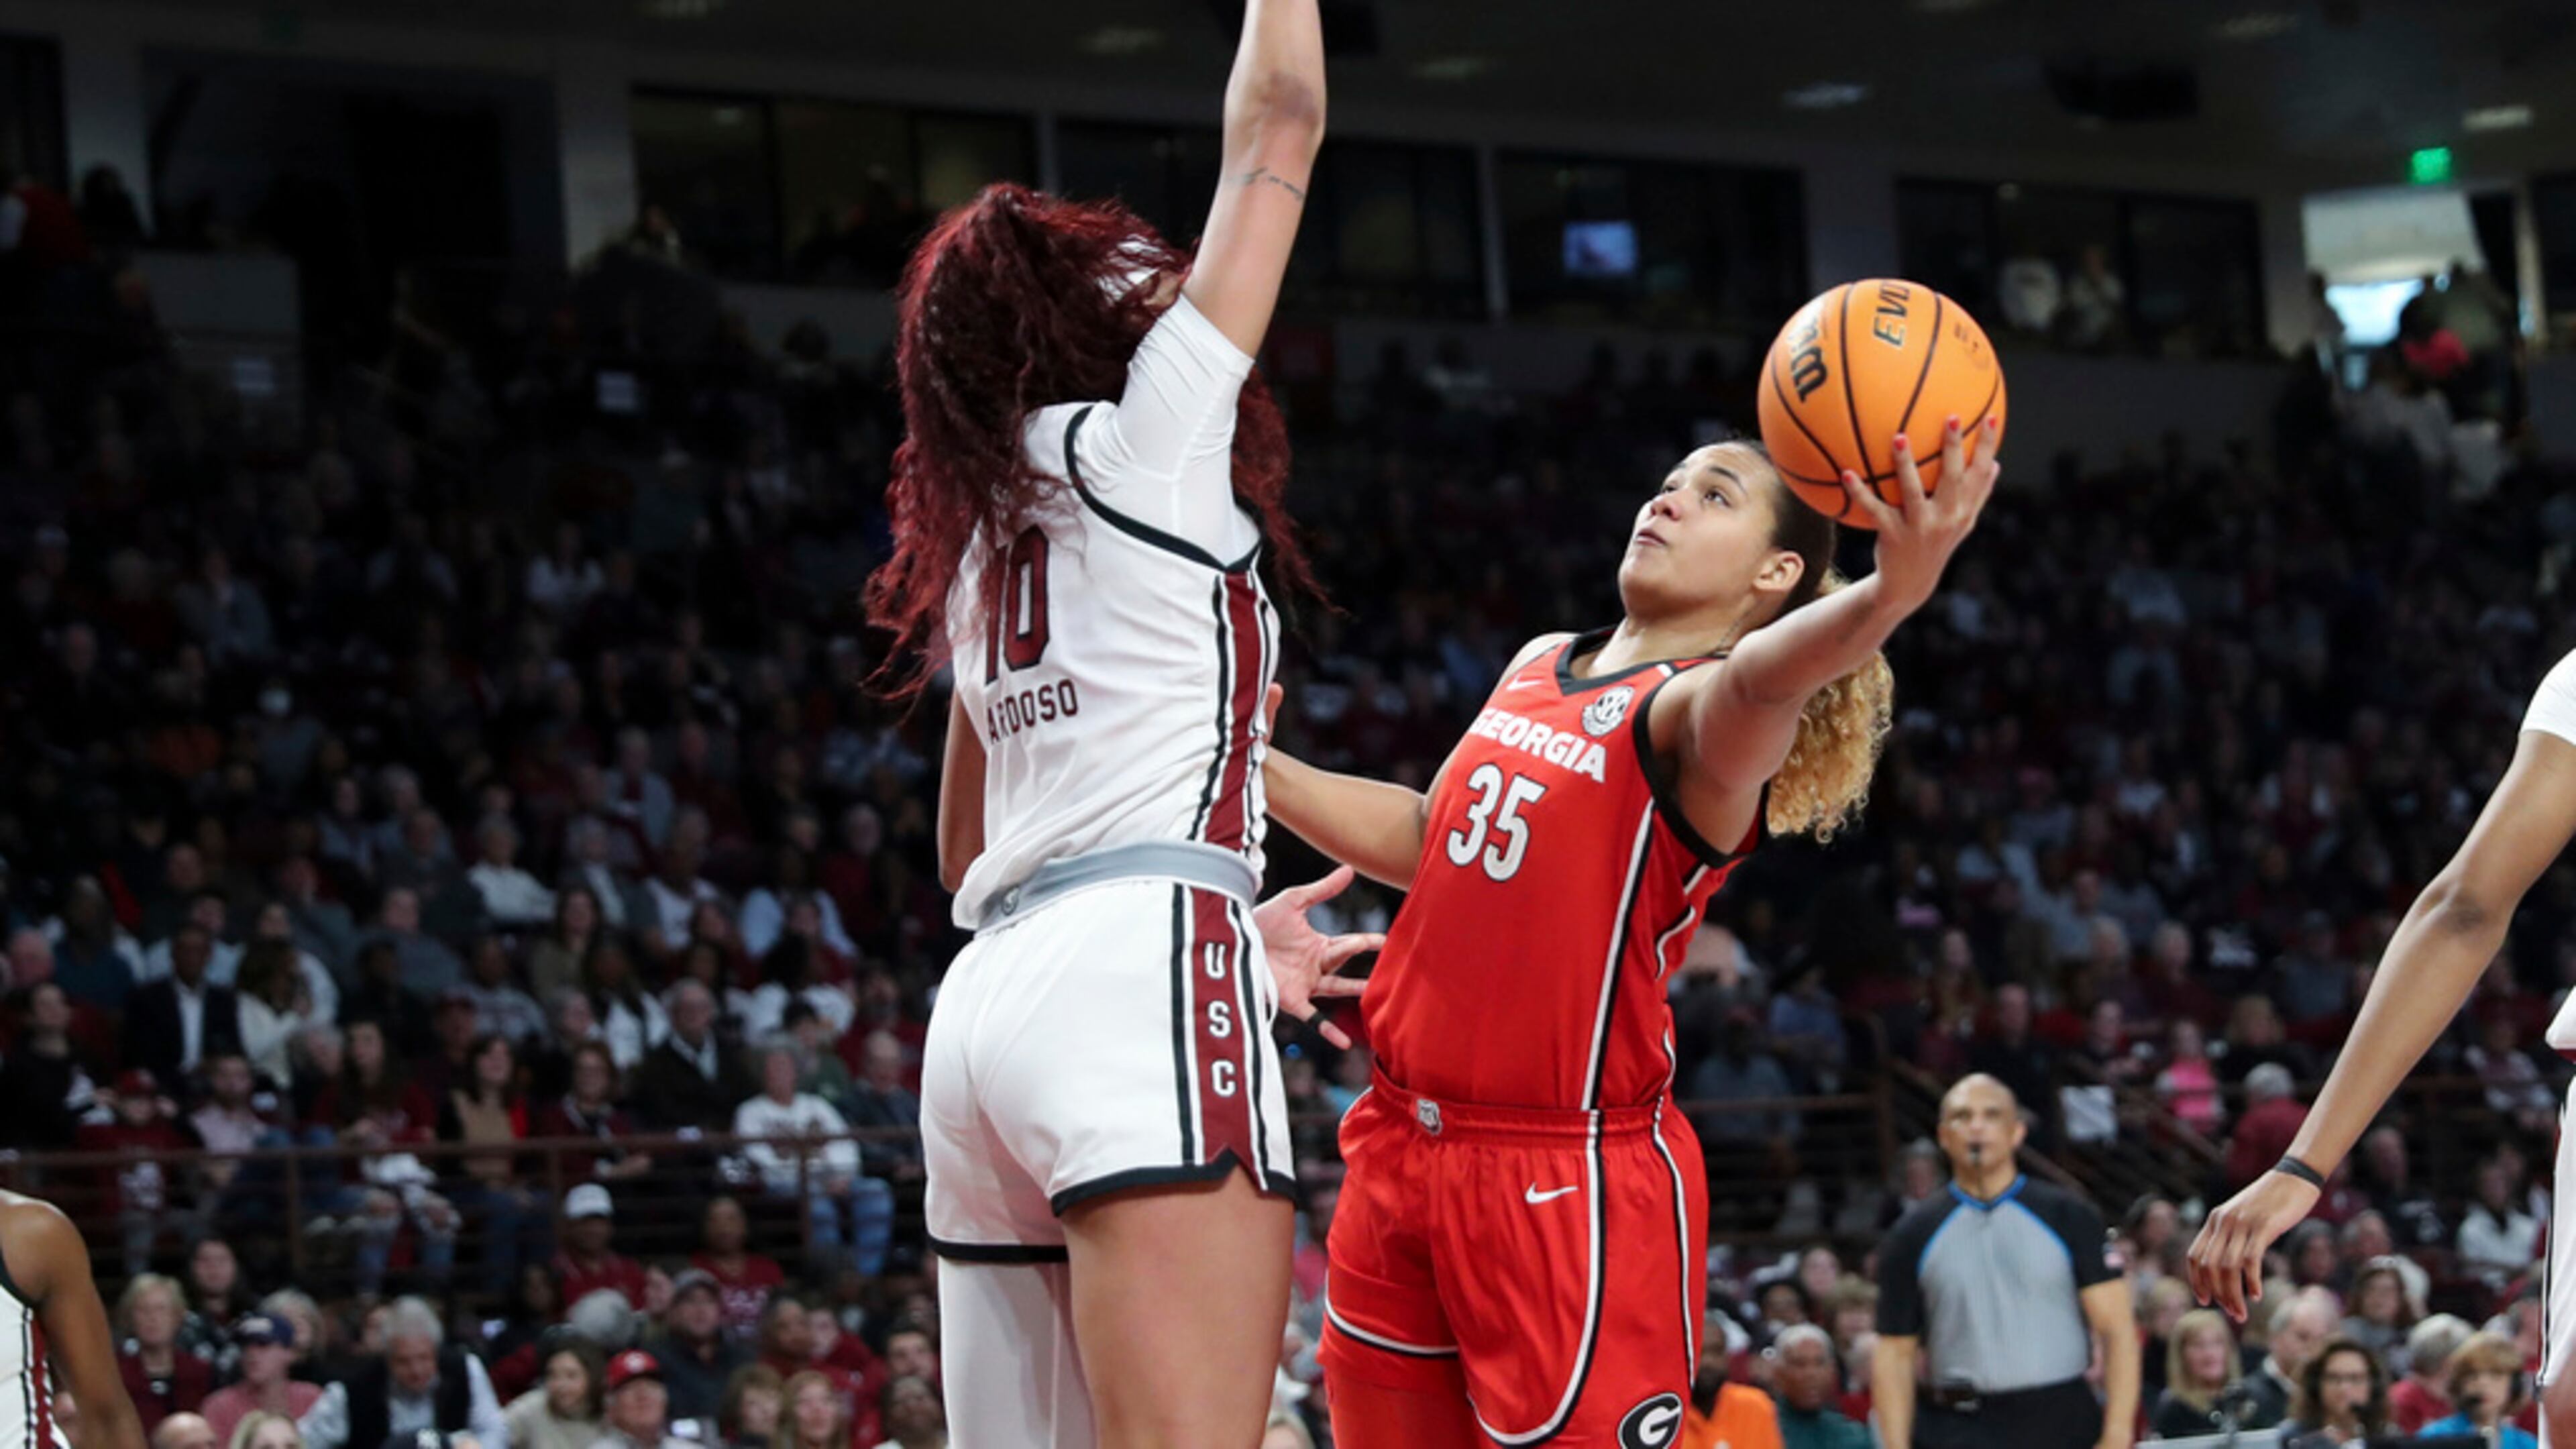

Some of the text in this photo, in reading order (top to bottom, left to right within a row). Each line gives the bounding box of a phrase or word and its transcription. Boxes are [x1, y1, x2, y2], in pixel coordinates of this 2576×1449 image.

[979, 525, 1050, 685] 10
[1468, 708, 1606, 782] GEORGIA
[1446, 763, 1548, 881] 35
[1205, 943, 1236, 1096] USC
